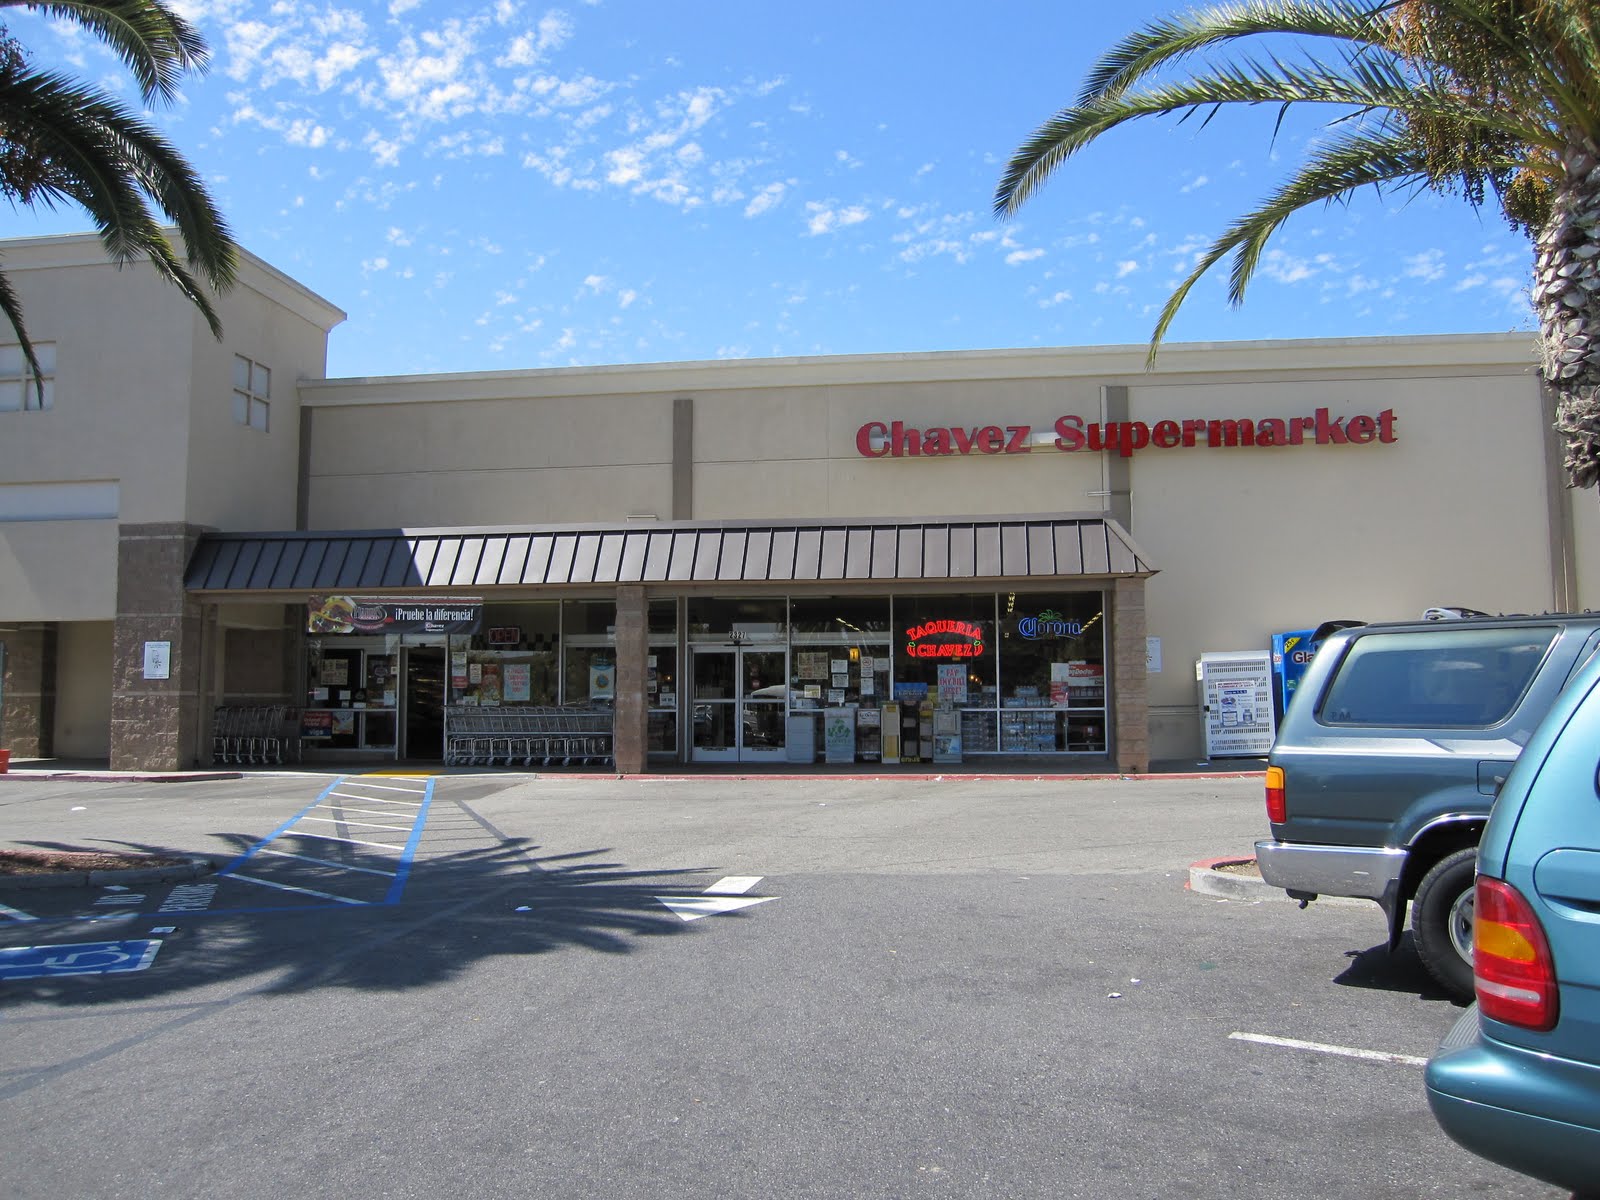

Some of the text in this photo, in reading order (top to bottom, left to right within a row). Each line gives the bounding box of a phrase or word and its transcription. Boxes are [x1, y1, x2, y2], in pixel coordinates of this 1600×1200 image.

[856, 407, 1398, 457] Chavez Supermarket
[395, 608, 474, 621] ¡Pruebe la diferencia!
[906, 620, 981, 640] TAQUERIA
[1018, 617, 1081, 637] Corona
[490, 629, 518, 643] OPEN
[729, 631, 746, 639] 2327
[917, 644, 973, 657] CHAVEZ
[1293, 651, 1314, 664] Gla
